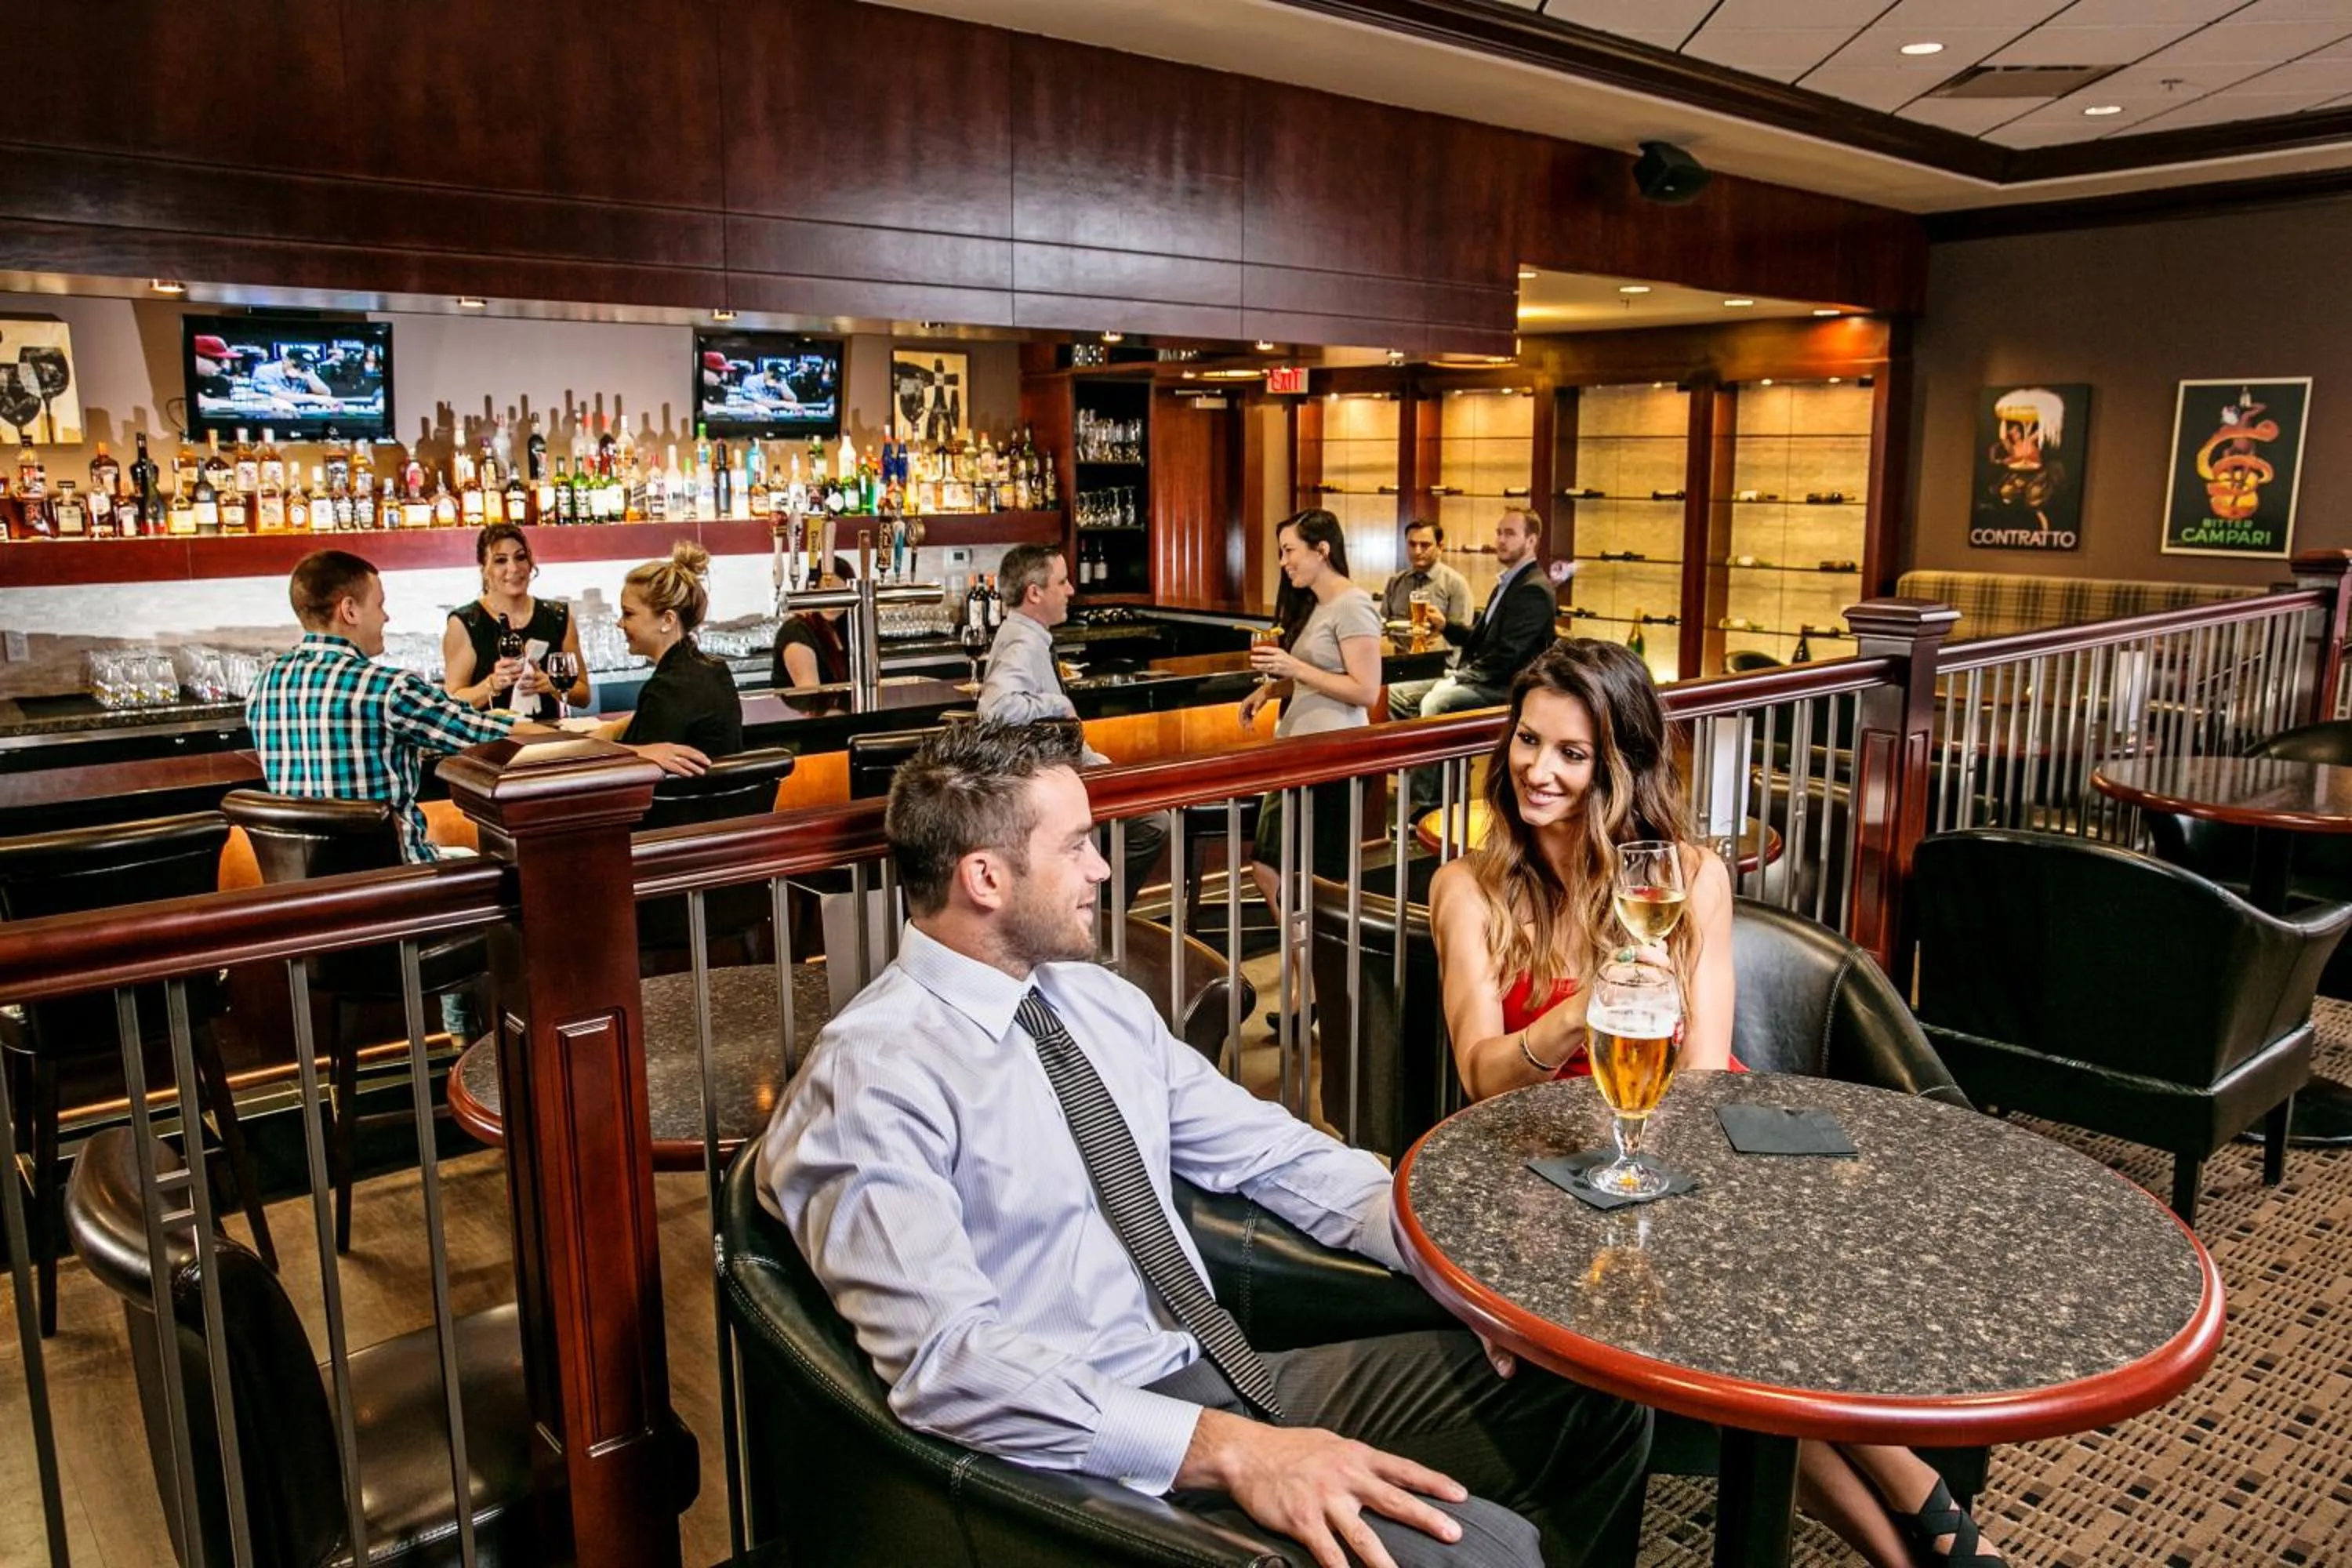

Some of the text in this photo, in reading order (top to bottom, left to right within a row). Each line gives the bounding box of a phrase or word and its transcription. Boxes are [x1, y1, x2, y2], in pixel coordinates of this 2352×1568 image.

[1272, 368, 1304, 390] EXIT
[1970, 528, 2076, 548] CONTRATTO
[2181, 528, 2271, 545] CAMPARI
